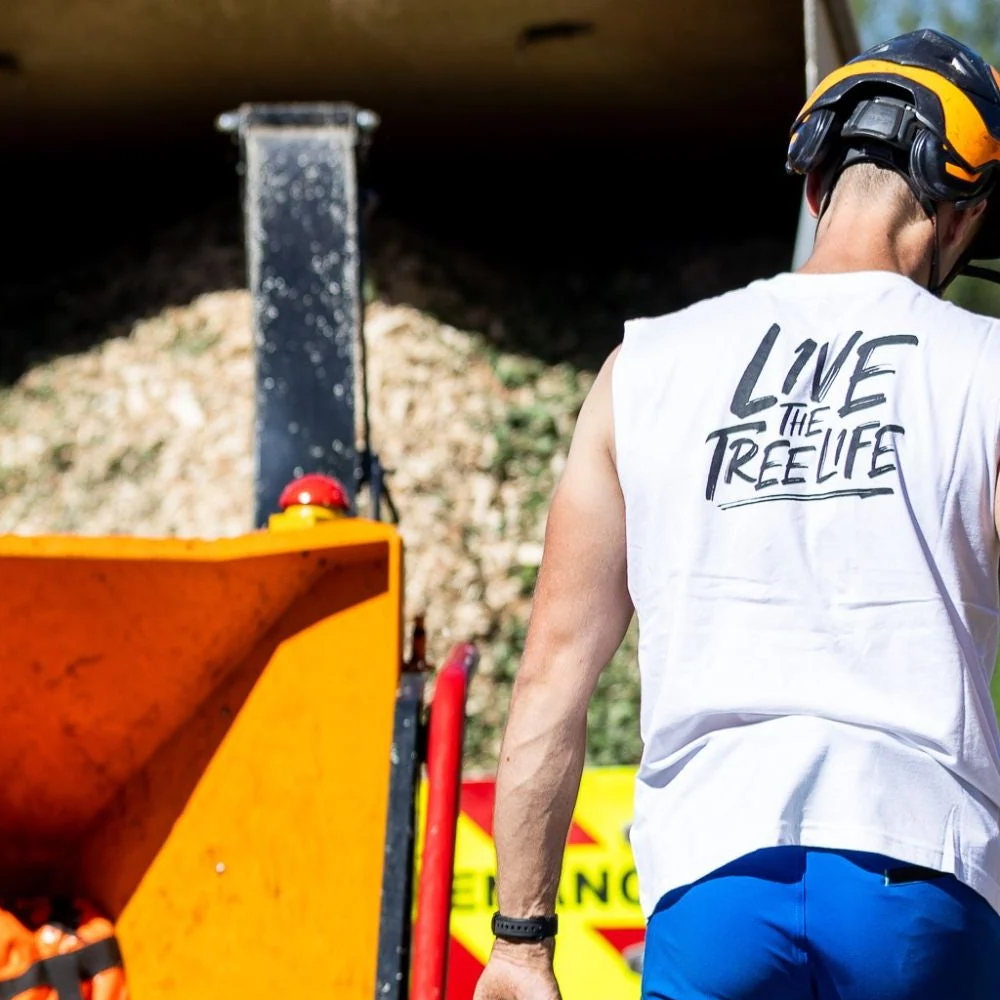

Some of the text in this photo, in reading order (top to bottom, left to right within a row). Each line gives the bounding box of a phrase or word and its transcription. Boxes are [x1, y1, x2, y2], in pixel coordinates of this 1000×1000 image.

[730, 322, 918, 419] LIVE
[778, 402, 830, 437] THE
[705, 420, 905, 501] TREELIFE
